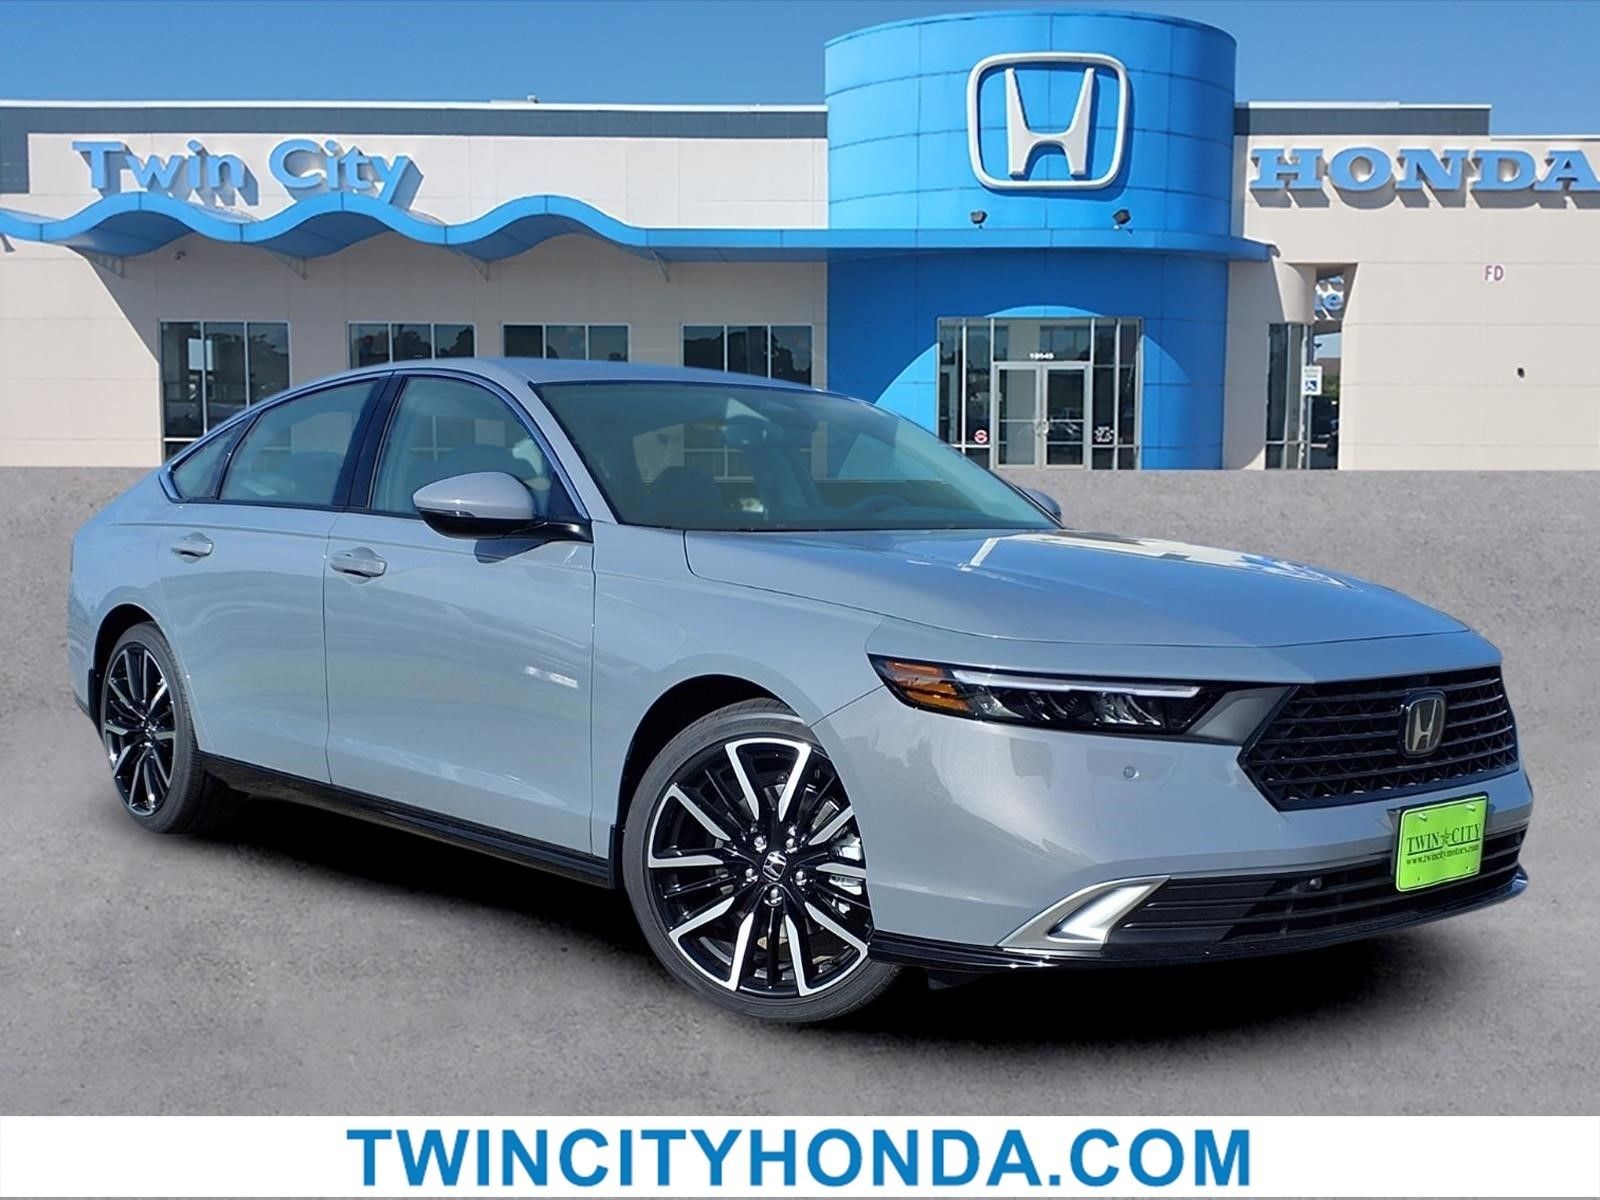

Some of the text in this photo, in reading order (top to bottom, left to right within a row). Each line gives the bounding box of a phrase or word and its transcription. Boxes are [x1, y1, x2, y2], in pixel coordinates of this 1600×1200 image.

[72, 138, 413, 205] Twin City
[1250, 146, 1600, 193] HONDA
[1484, 264, 1504, 281] FD
[1452, 823, 1481, 842] CITY
